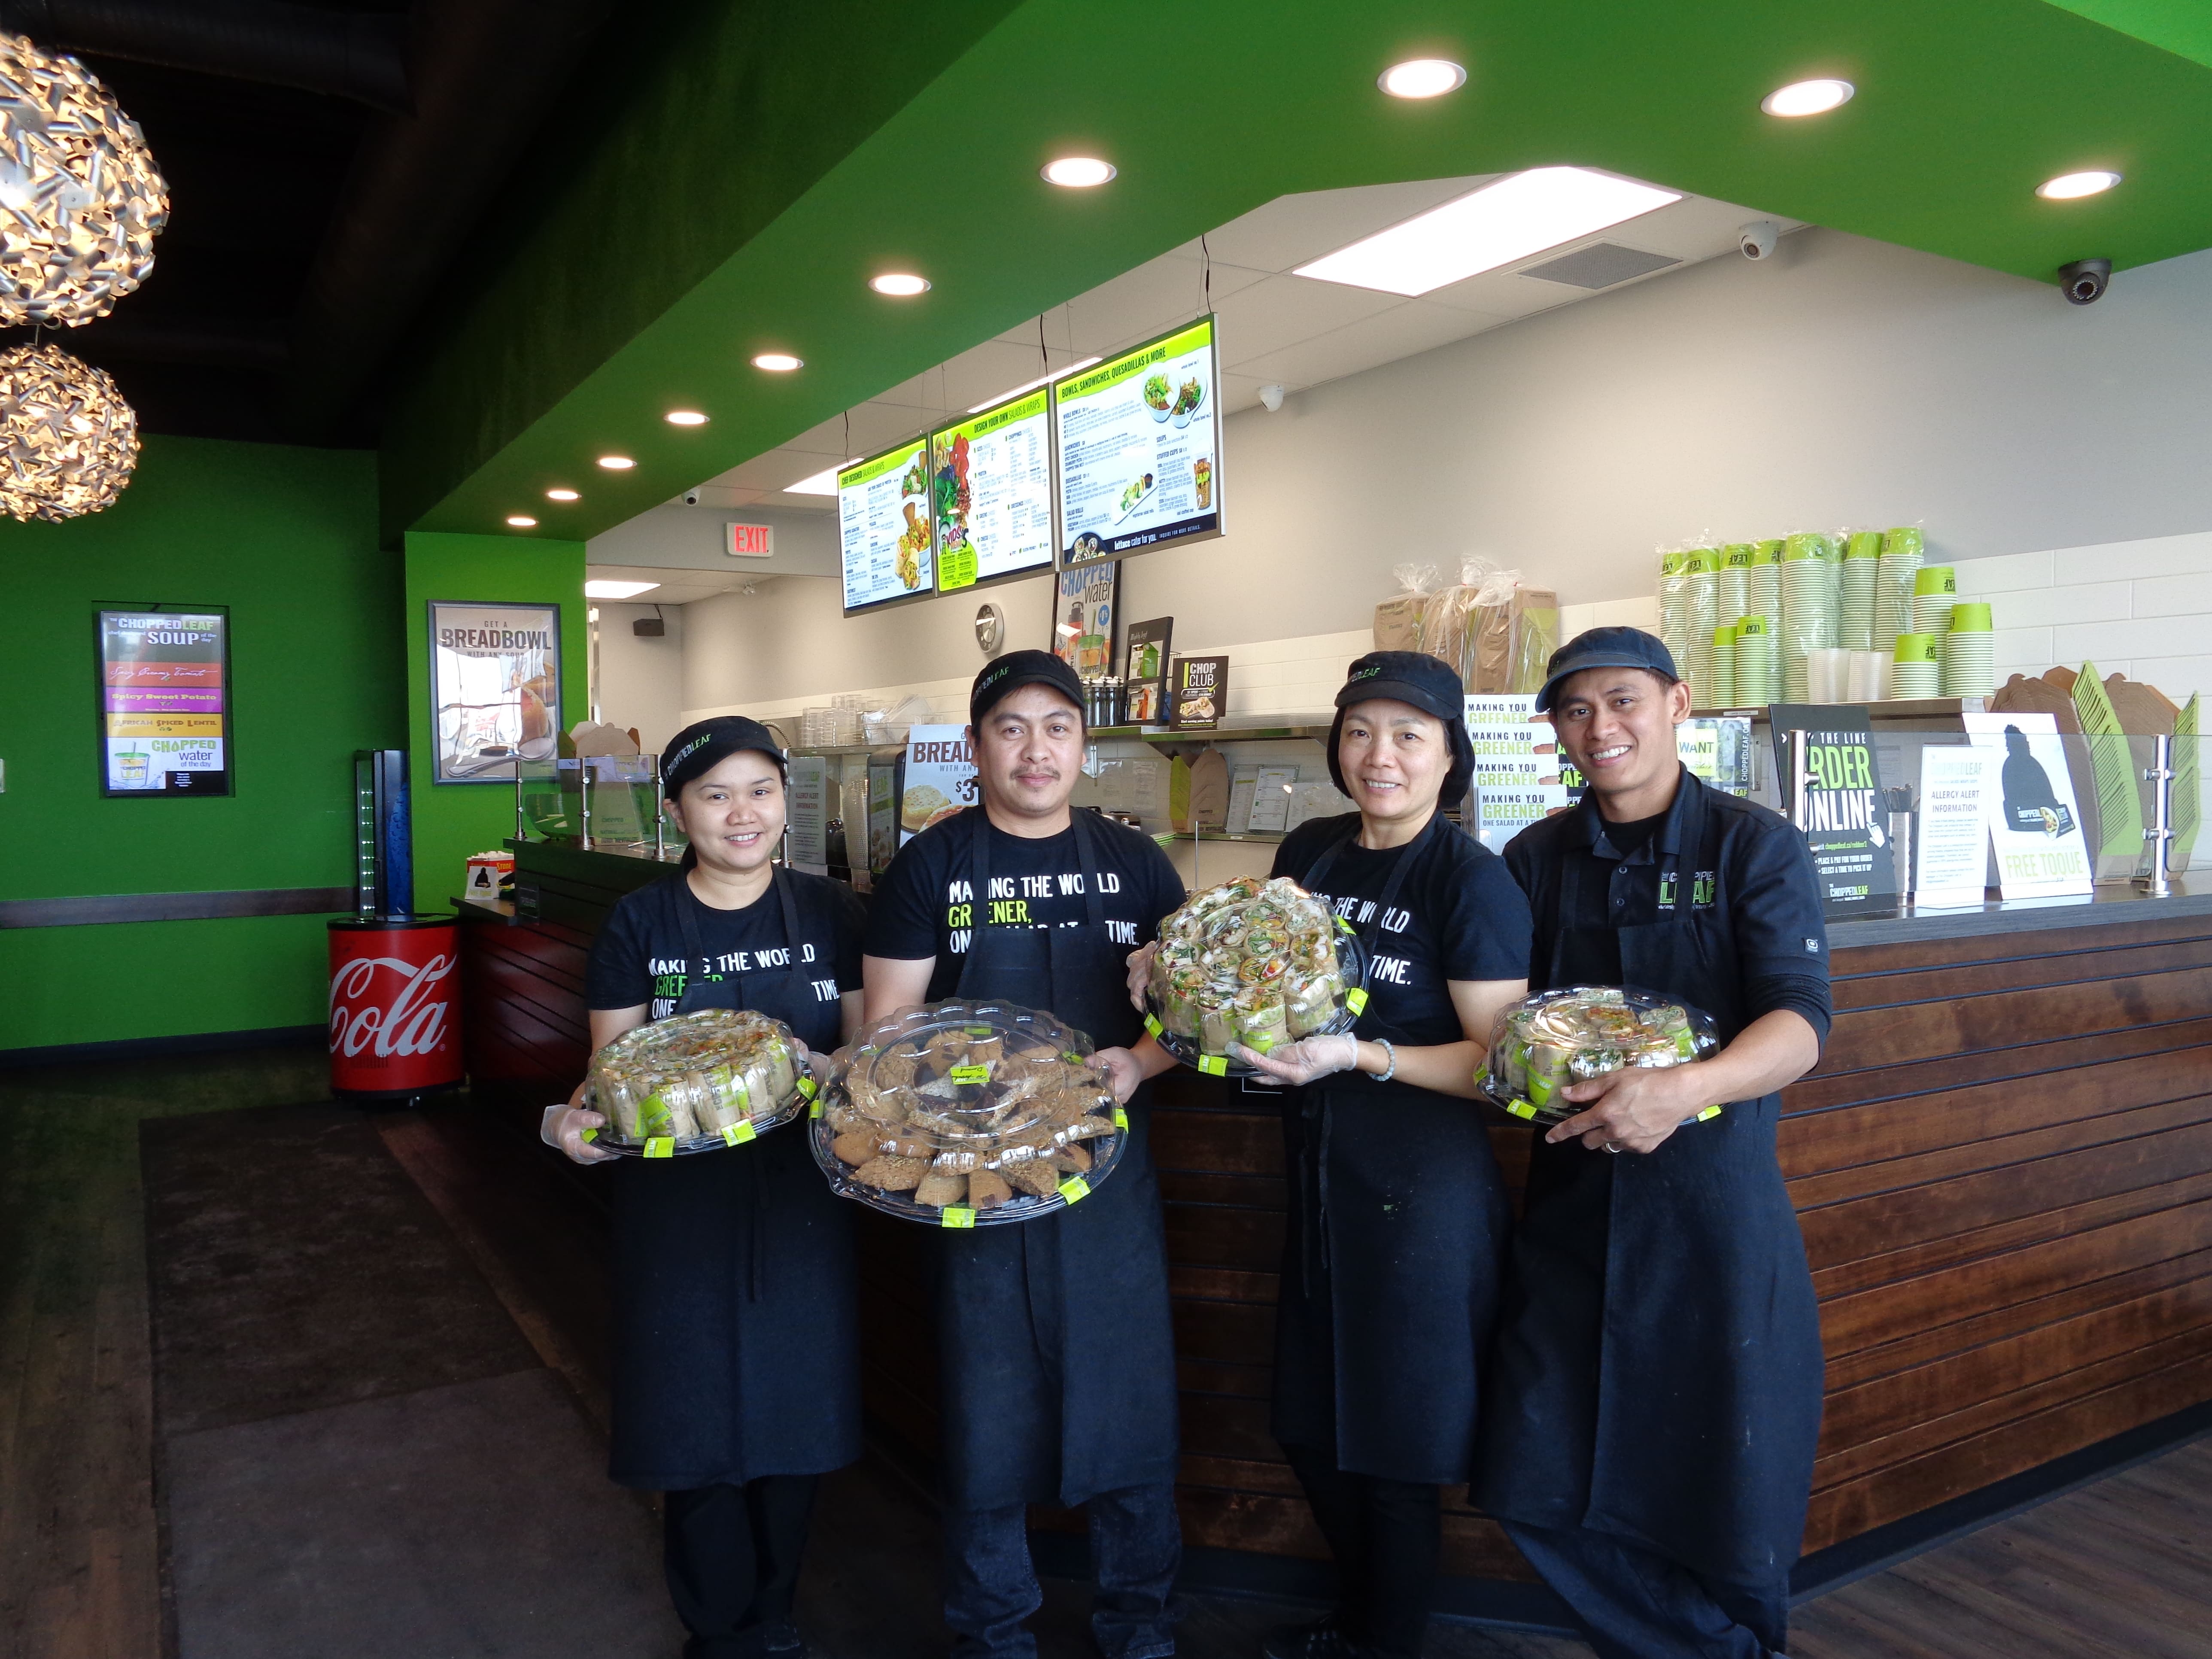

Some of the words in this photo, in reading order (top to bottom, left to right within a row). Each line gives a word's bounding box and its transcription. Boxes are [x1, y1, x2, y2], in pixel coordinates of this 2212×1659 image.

[1062, 383, 1079, 398] BOWLS,
[1080, 372, 1111, 391] SANDWICHES,
[1112, 357, 1145, 379] QUESADILLAS
[1146, 354, 1150, 365] &
[1151, 347, 1166, 363] MORE
[974, 422, 988, 433] DESIGN
[988, 417, 999, 428] YOUR
[1000, 412, 1008, 423] OWN
[1009, 406, 1022, 420] SALADS
[1027, 399, 1040, 412] WRAPS
[1157, 434, 1166, 443] SOUPS
[1157, 451, 1169, 460] STUFFED
[849, 471, 862, 482] DESIGNED
[735, 525, 768, 553] EXIT
[946, 525, 961, 547] KIDS
[1115, 540, 1130, 550] lettuce
[1131, 537, 1141, 546] cater
[1148, 533, 1157, 544] you.
[1729, 554, 1747, 562] LEAF
[1061, 562, 1113, 597] CHOPPED
[1085, 579, 1112, 604] water
[147, 631, 199, 644] SOUP
[441, 629, 551, 650] BREADBOWL
[1190, 662, 1216, 674] CHOP
[1189, 674, 1214, 687] CLUB
[1509, 704, 1527, 712] YOU
[1469, 713, 1527, 723] GREENER
[1514, 732, 1531, 741] YOU
[1820, 733, 1838, 744] THE
[1844, 732, 1867, 744] LINE
[152, 740, 216, 752] CHOPPED
[1473, 741, 1532, 754] GREENER
[179, 751, 213, 760] water
[1477, 764, 1514, 772] MAKING
[1519, 764, 1537, 772] YOU
[1806, 745, 1874, 790] RDER
[1478, 773, 1537, 786] GREENER
[1483, 795, 1521, 803] MAKING
[1526, 795, 1545, 803] YOU
[1483, 804, 1545, 818] GREENER
[1932, 804, 1977, 813] INFORMATION
[2005, 854, 2038, 878] FREE
[2039, 852, 2083, 877] TOQUE
[948, 877, 1015, 903] MAING
[1020, 875, 1053, 898] THE
[1057, 873, 1120, 896] WOLD
[1659, 880, 1715, 903] LAF
[1830, 885, 1868, 897] CHOPPEDLEAF
[1335, 896, 1358, 920] THE
[950, 929, 972, 954] ON
[1104, 920, 1139, 946] TIME.
[648, 957, 711, 976] MAKIG
[716, 951, 751, 972] THE
[754, 943, 815, 969] WORD
[1369, 954, 1412, 985] TIME.
[330, 954, 457, 1057] Cola
[652, 998, 677, 1020] ONE
